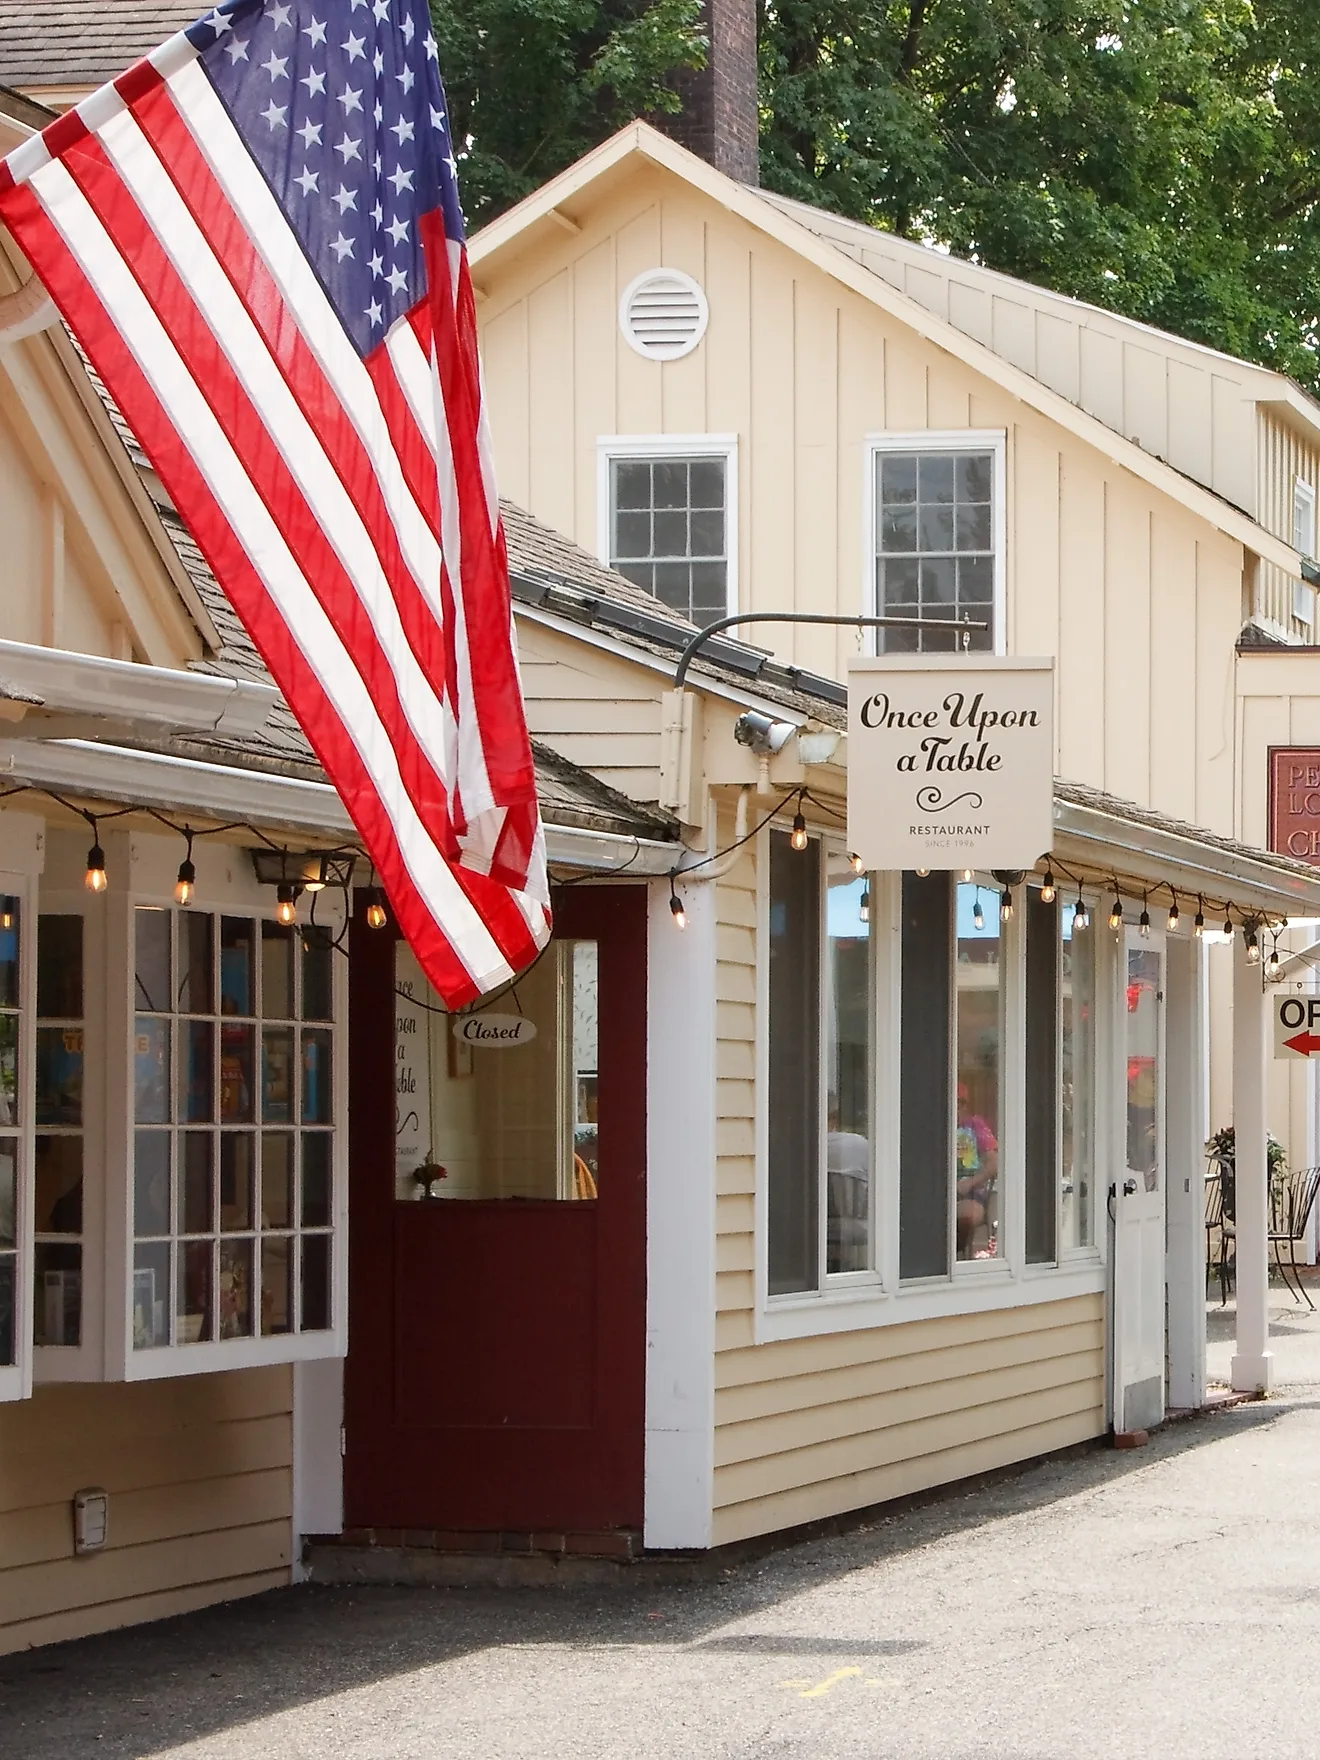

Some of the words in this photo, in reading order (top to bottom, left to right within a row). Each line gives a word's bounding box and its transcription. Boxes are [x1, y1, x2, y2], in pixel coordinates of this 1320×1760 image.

[860, 693, 940, 729] Once
[942, 692, 1041, 742] Upon
[896, 755, 919, 773] a
[920, 736, 1003, 773] Table
[909, 825, 991, 835] RESTAURANT
[924, 840, 951, 848] SINCE
[462, 1019, 523, 1041] Closed
